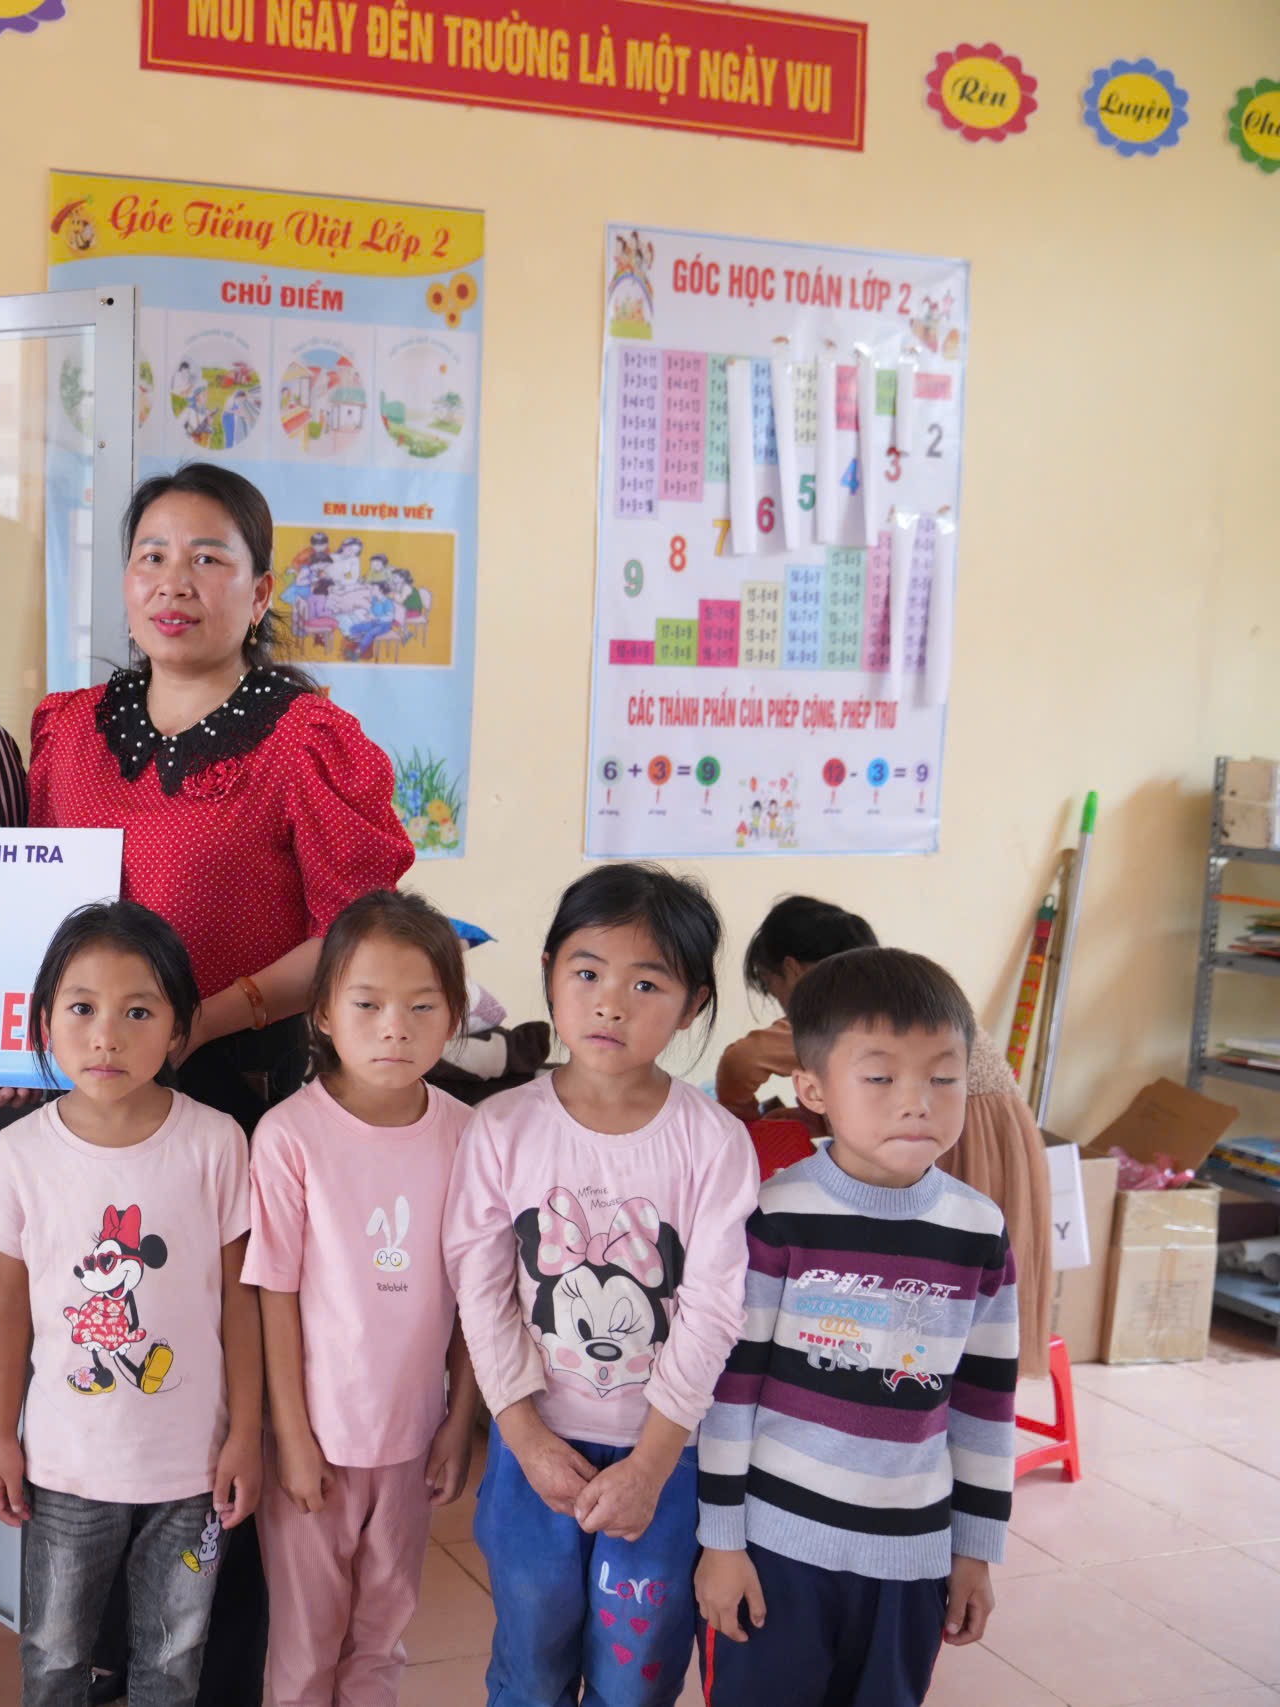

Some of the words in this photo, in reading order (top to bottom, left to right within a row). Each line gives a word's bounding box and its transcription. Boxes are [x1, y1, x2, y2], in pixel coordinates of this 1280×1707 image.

[443, 10, 569, 80] TRƯỜNG
[580, 25, 616, 86] LÀ
[626, 33, 691, 105] MỘT
[699, 45, 778, 106] NGÀY
[786, 61, 832, 113] VUI
[951, 76, 1007, 108] Rèn
[1100, 92, 1171, 123] Luyện
[108, 195, 172, 239] Góc
[184, 201, 277, 248] Tiếng
[284, 211, 352, 258] Việt
[360, 217, 422, 262] Lớp
[432, 228, 450, 258] 2
[221, 275, 271, 305] CHỦ
[280, 279, 344, 312] ĐIỂM
[673, 254, 720, 296] GÓC
[729, 264, 775, 307] HỌC
[784, 266, 841, 309] TOÁN
[849, 269, 891, 313] LỚP
[898, 283, 911, 315] 2
[926, 424, 943, 458] 2
[841, 458, 860, 496] 4
[885, 447, 901, 482] 3
[323, 502, 347, 515] EM
[352, 501, 398, 520] LUYỆN
[403, 504, 434, 520] VIẾT
[798, 474, 816, 510] 5
[757, 496, 775, 534] 6
[669, 535, 687, 572] 8
[712, 518, 731, 557] 7
[624, 559, 644, 598] 9
[627, 689, 655, 726] CÁC
[603, 761, 617, 780] 6
[654, 761, 666, 780] 3
[702, 761, 715, 781] 9
[827, 764, 844, 783] 12
[873, 763, 885, 782] 3
[916, 764, 929, 783] 9
[25, 845, 64, 864] TRA
[792, 1268, 961, 1304] PILOT
[599, 1561, 667, 1605] Love
